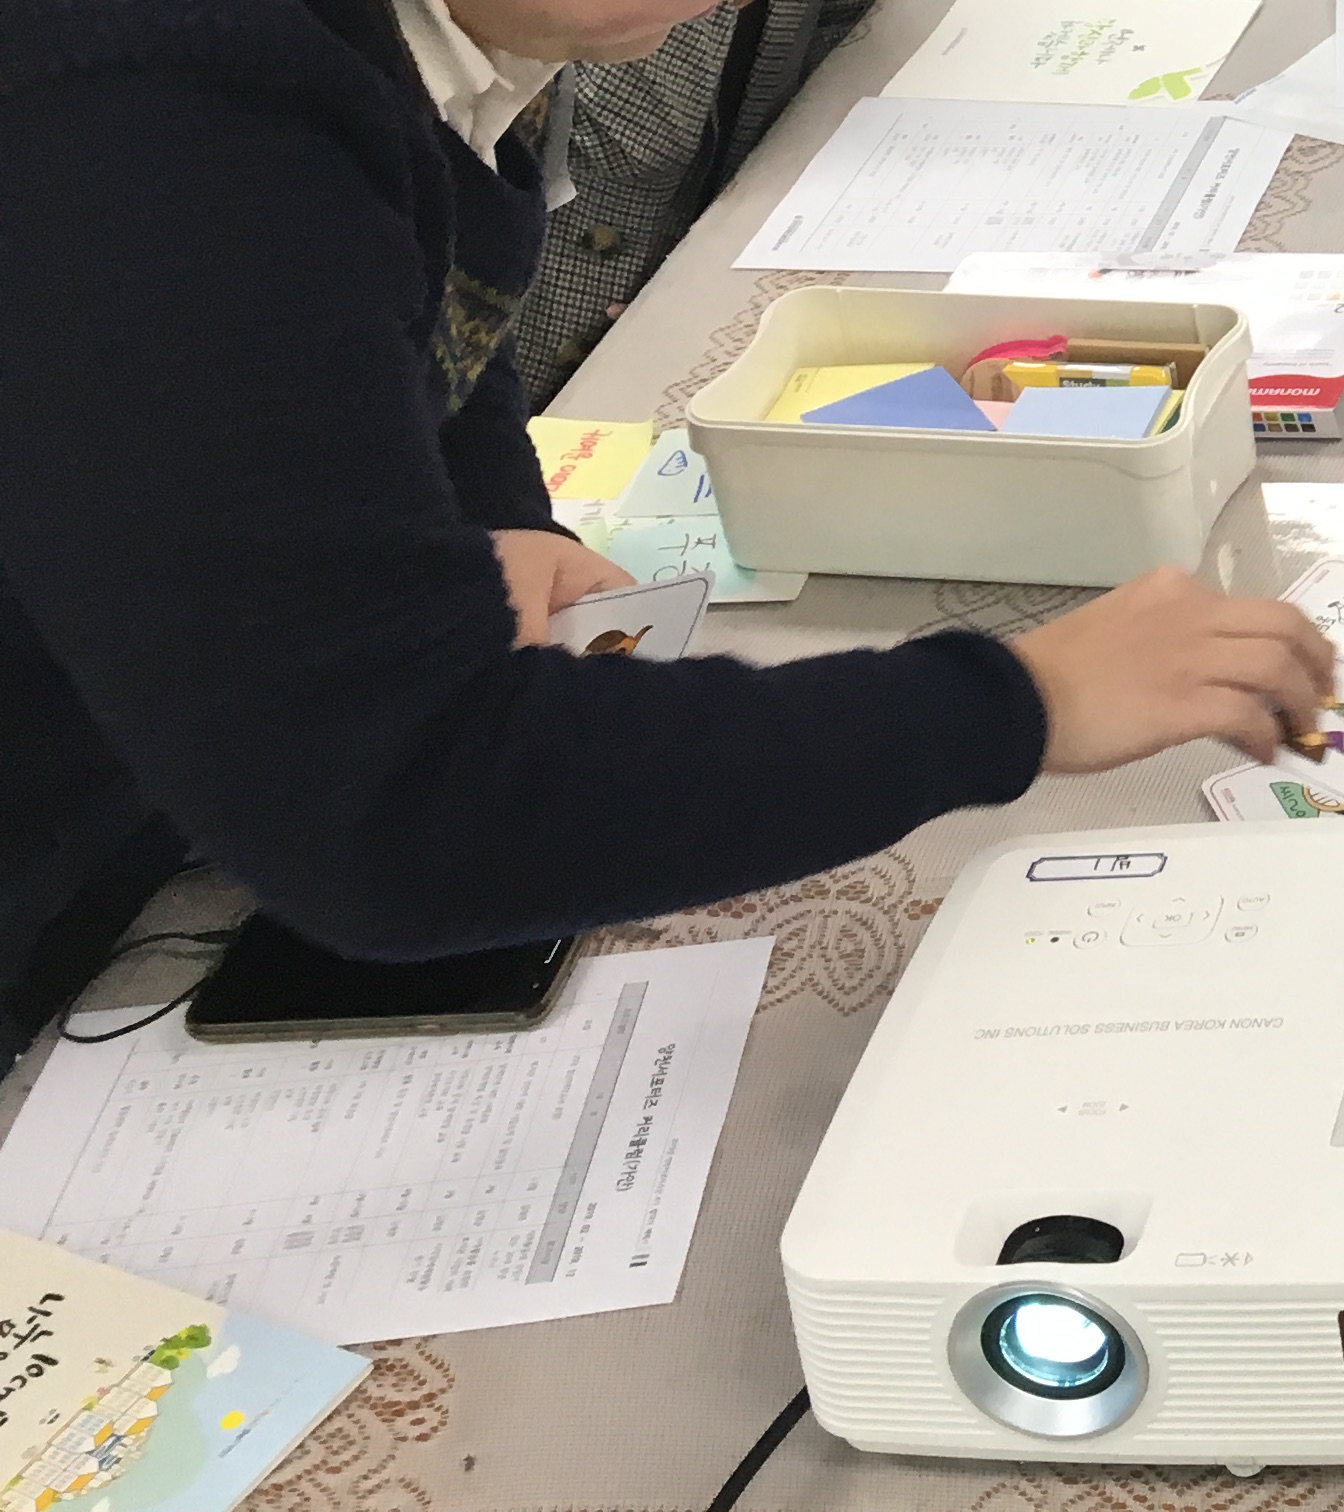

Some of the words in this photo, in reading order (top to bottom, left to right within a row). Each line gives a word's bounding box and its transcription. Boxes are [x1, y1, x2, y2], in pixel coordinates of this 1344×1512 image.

[1005, 1023, 1092, 1039] SOLUTIONS
[1095, 1020, 1172, 1036] BUSINESS
[1174, 1018, 1228, 1033] KOREA
[1229, 1016, 1284, 1031] CANON
